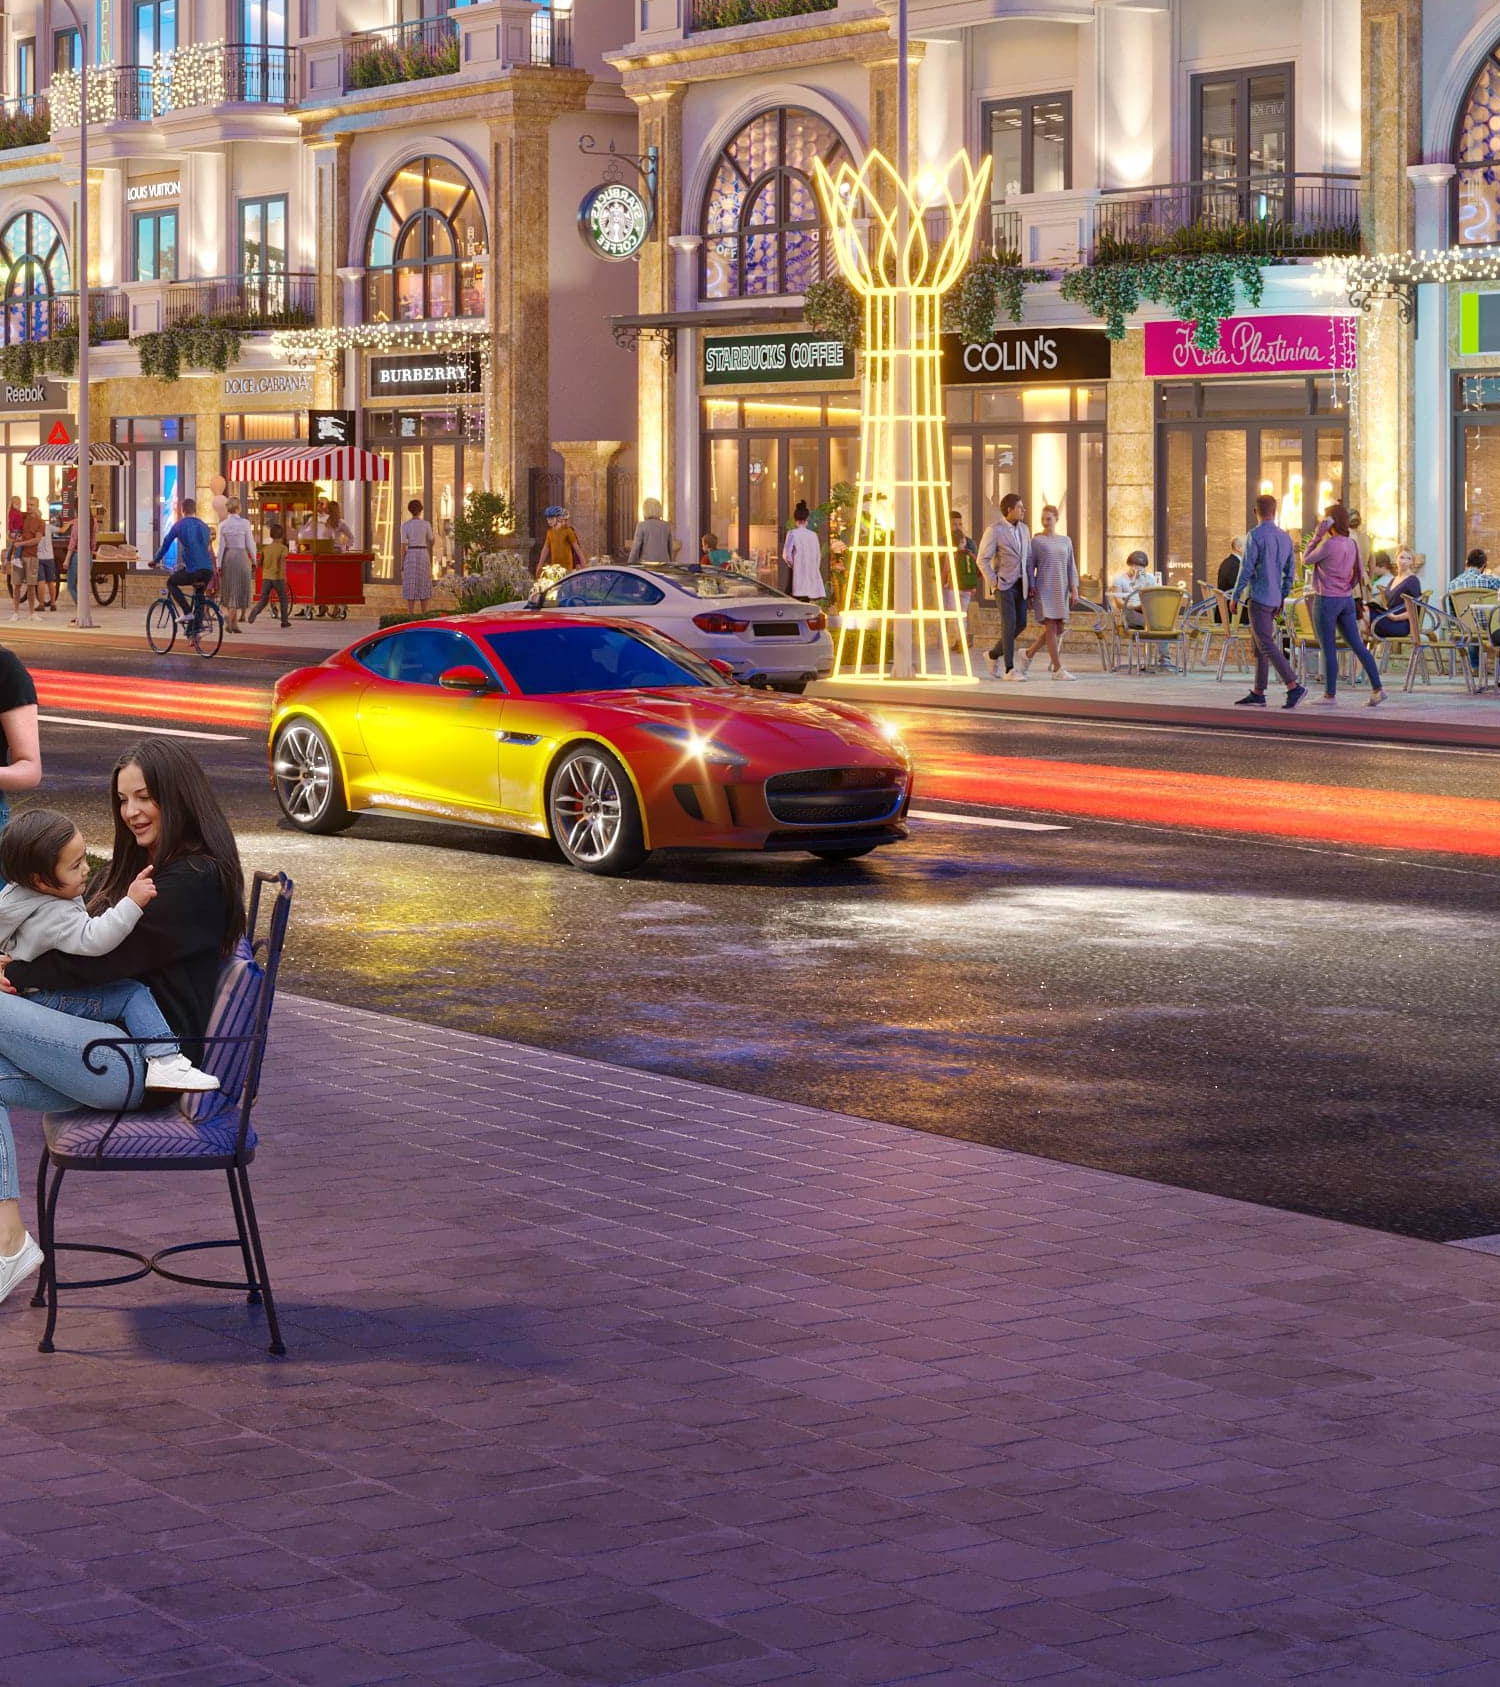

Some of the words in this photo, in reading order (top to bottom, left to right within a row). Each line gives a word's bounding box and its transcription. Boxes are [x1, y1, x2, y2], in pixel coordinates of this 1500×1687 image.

[127, 184, 148, 201] LOUIS
[148, 180, 181, 199] VUITTON
[716, 243, 738, 259] OFF
[963, 335, 1058, 373] COLIN'S
[1230, 321, 1326, 366] Plastinina
[705, 343, 786, 372] STARBUCKS
[790, 341, 844, 369] COFFEE
[379, 365, 468, 384] BURBERRY
[5, 384, 45, 404] Reebok
